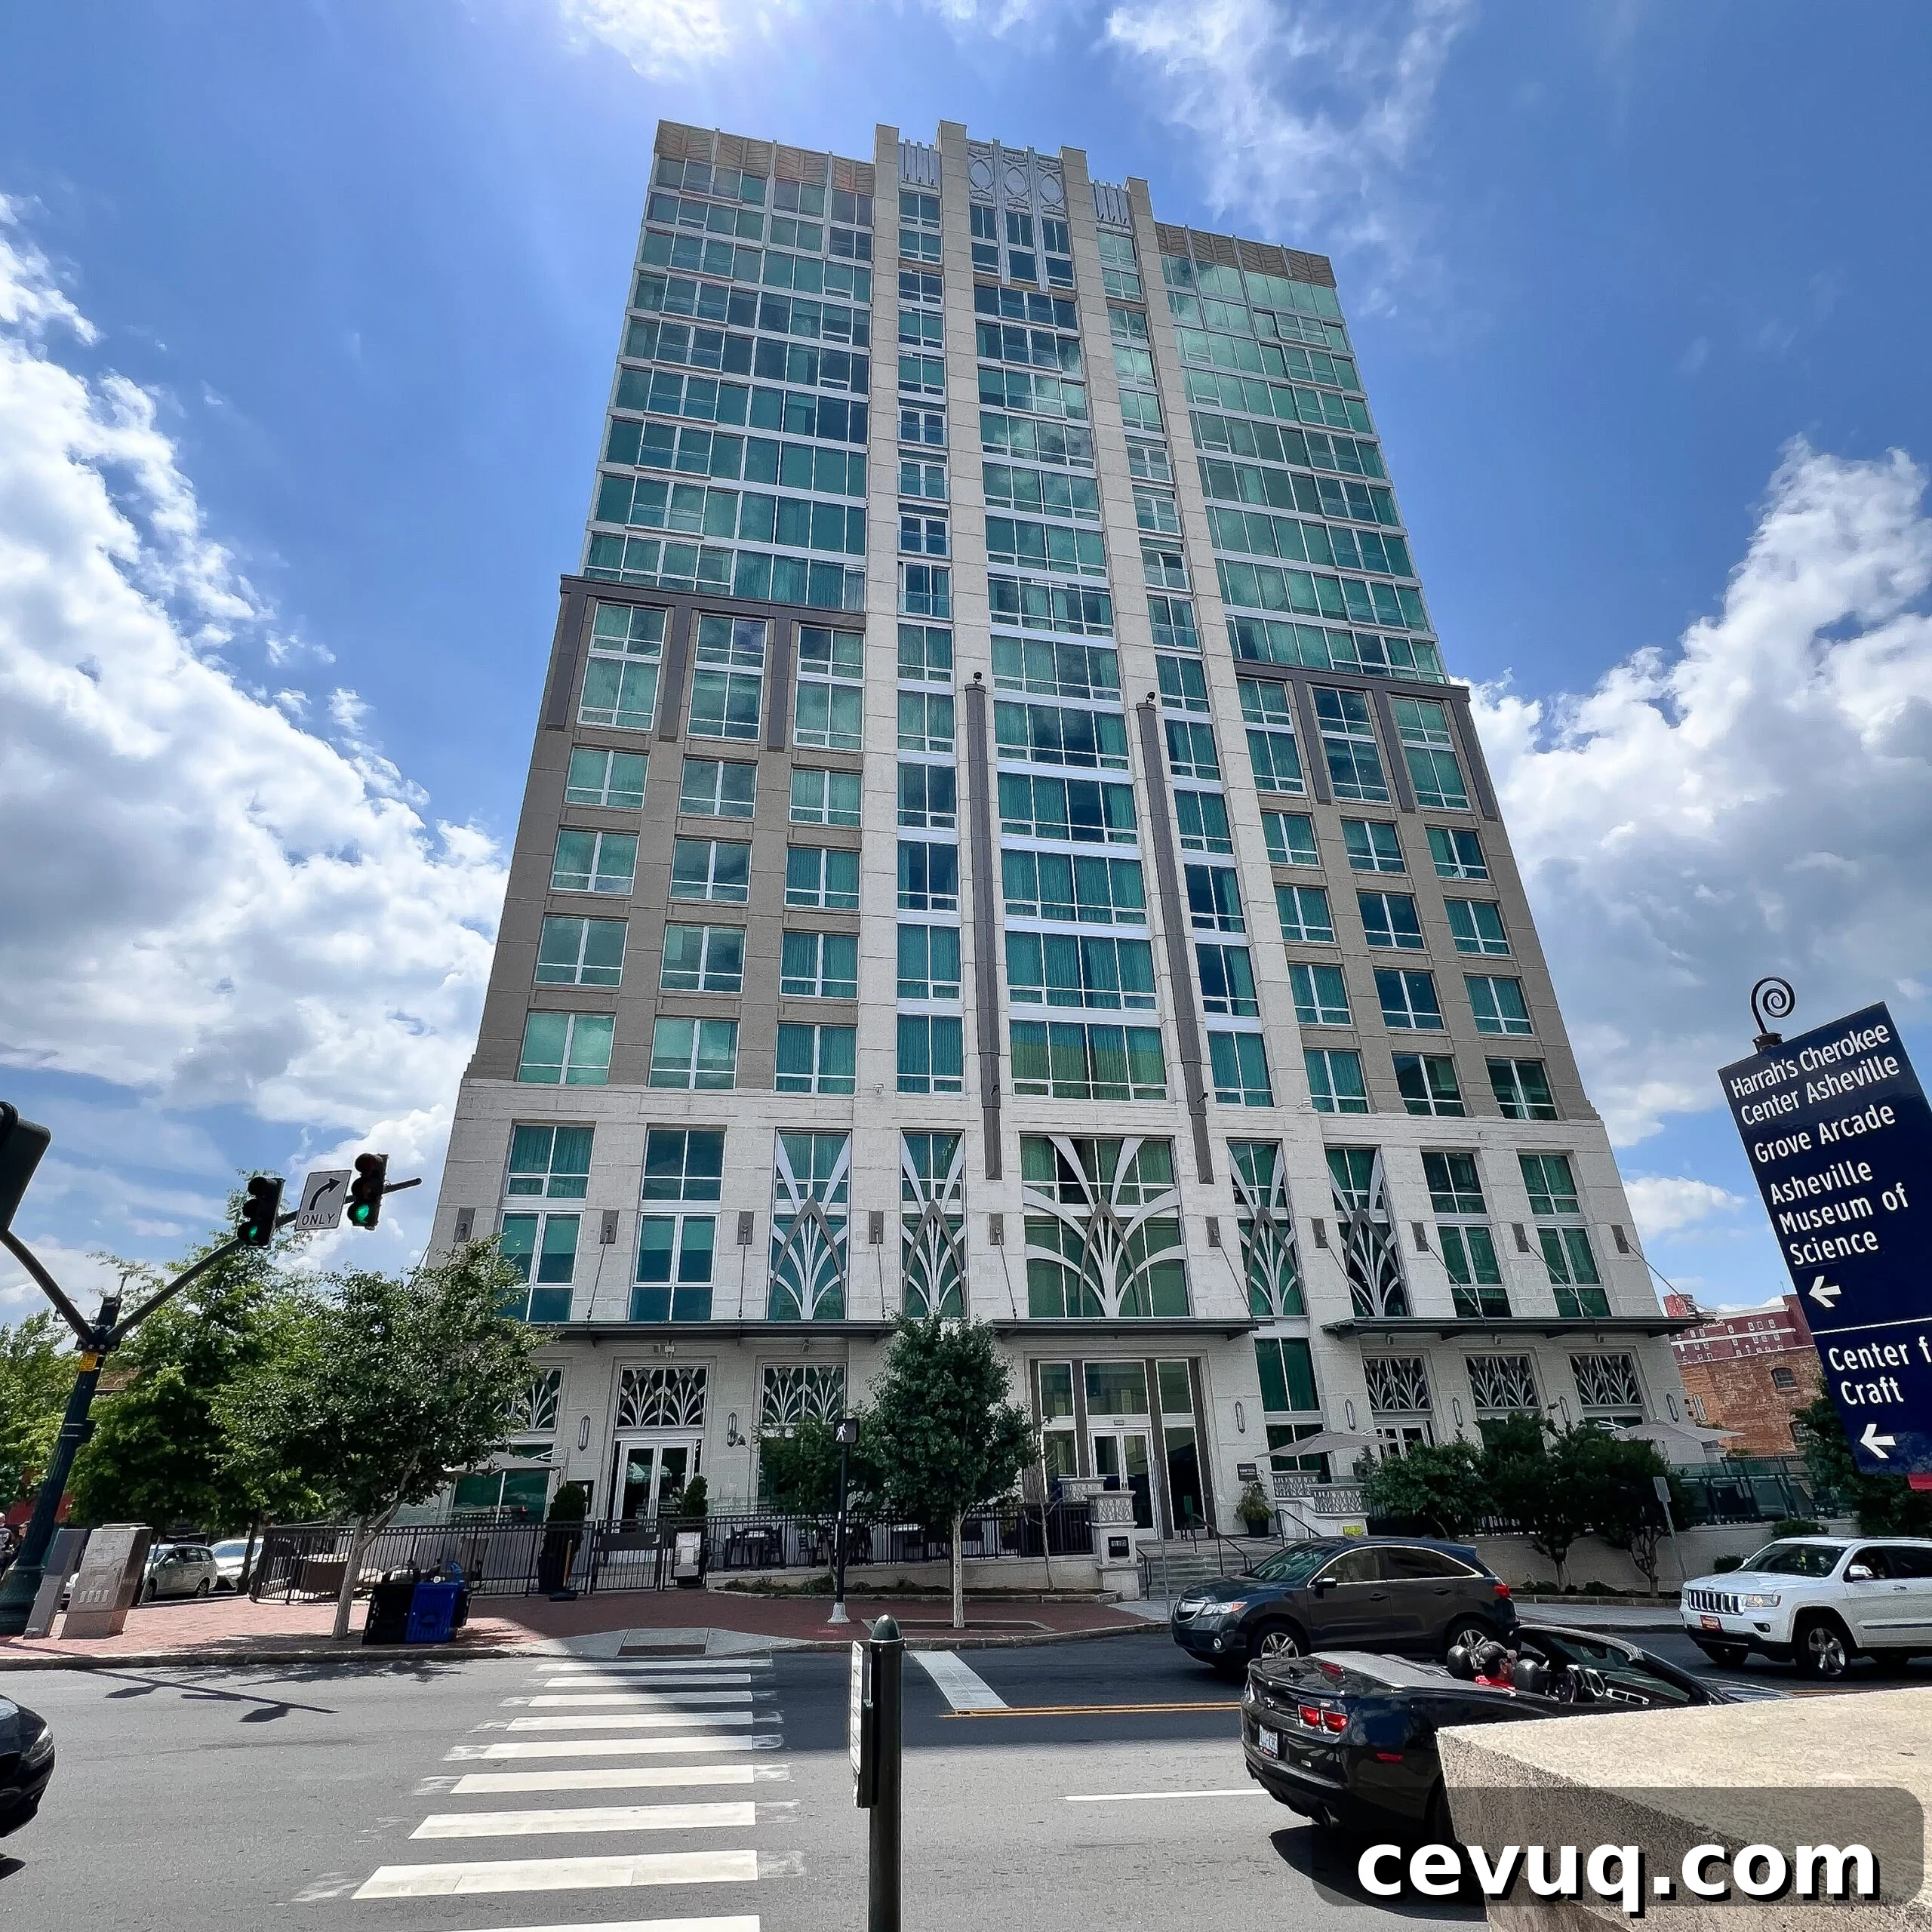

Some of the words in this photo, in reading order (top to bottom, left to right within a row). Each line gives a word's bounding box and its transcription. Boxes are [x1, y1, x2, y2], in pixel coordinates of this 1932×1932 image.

[1730, 1058, 1799, 1099] Harrah's
[1799, 1024, 1890, 1072] Cherokee
[1741, 1090, 1800, 1125] Center
[1806, 1056, 1900, 1104] Asheville
[1755, 1132, 1812, 1163] Grove
[1818, 1104, 1896, 1145] Arcade
[1770, 1160, 1873, 1205] Asheville
[302, 1213, 336, 1226] ONLY
[1778, 1197, 1873, 1235] Museum
[1881, 1182, 1909, 1211] of
[1789, 1231, 1879, 1265] Science
[1829, 1343, 1910, 1371] Center
[1841, 1376, 1904, 1405] Craft
